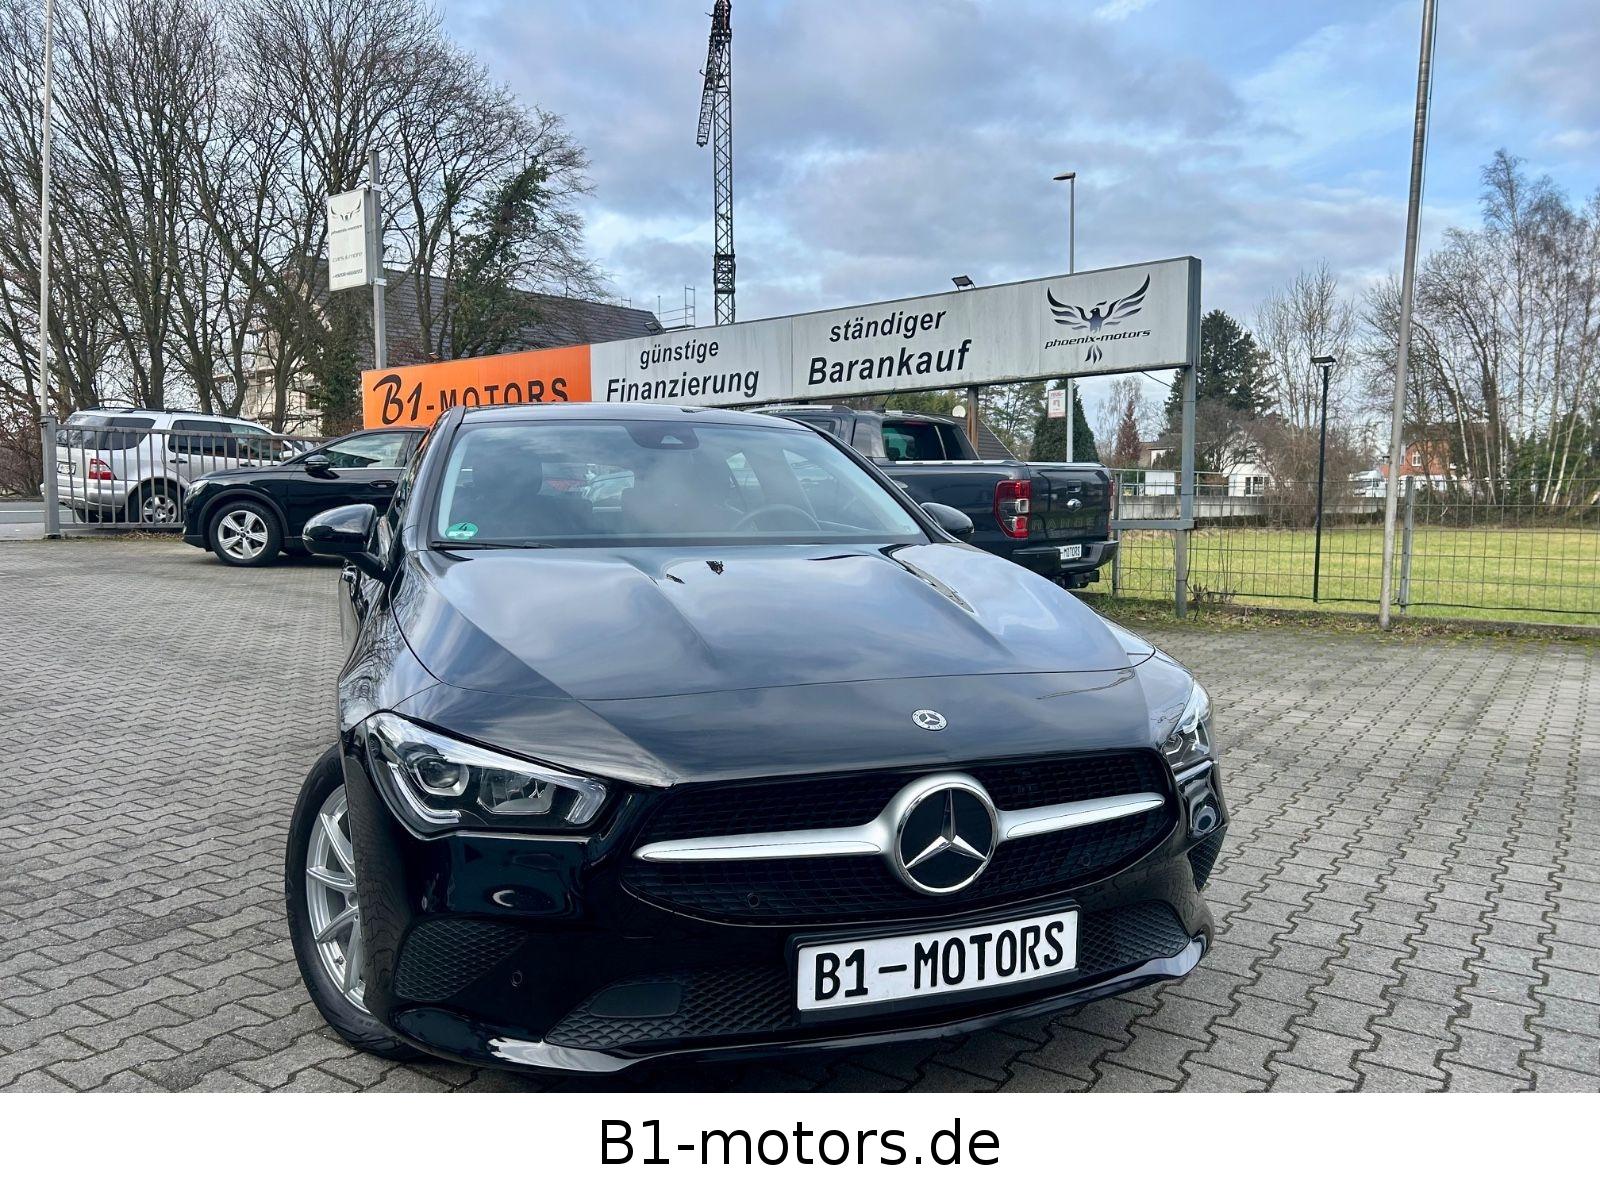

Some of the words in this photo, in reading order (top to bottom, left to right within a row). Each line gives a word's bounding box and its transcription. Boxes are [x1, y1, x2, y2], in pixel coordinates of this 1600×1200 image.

[829, 310, 947, 343] ständiger
[1044, 329, 1152, 349] phoenix-motors
[640, 339, 720, 369] günstige
[807, 339, 973, 386] Barankauf
[606, 369, 760, 402] Finanzierung
